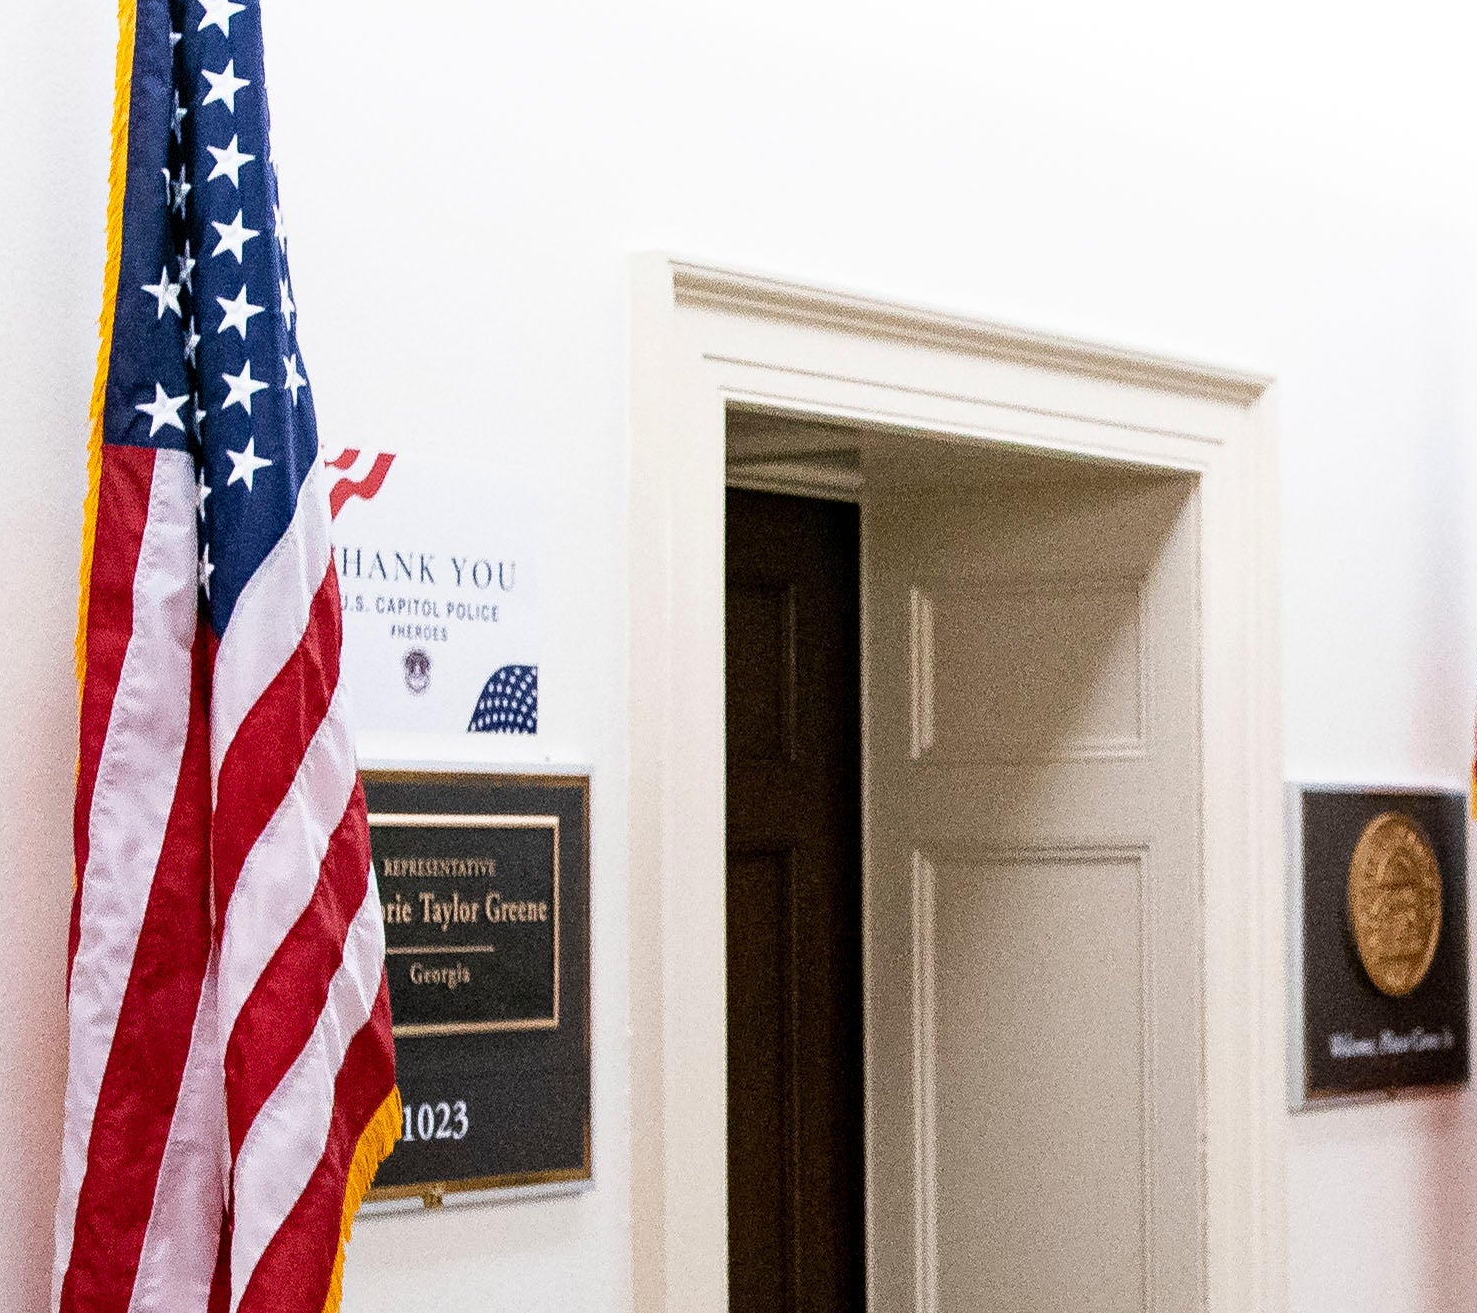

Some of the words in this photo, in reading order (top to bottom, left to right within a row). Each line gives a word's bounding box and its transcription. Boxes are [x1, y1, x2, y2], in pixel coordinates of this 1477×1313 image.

[341, 545, 436, 585] HANK
[450, 556, 516, 592] YOU
[375, 596, 440, 619] CAPITOL
[446, 601, 499, 623] POLICE
[390, 624, 448, 642] #HEROES
[383, 858, 497, 877] REPRESENTATIVE
[418, 892, 480, 931] Taylor
[485, 893, 548, 923] Greene
[409, 962, 471, 989] Georgia
[403, 1100, 469, 1142] 1023
